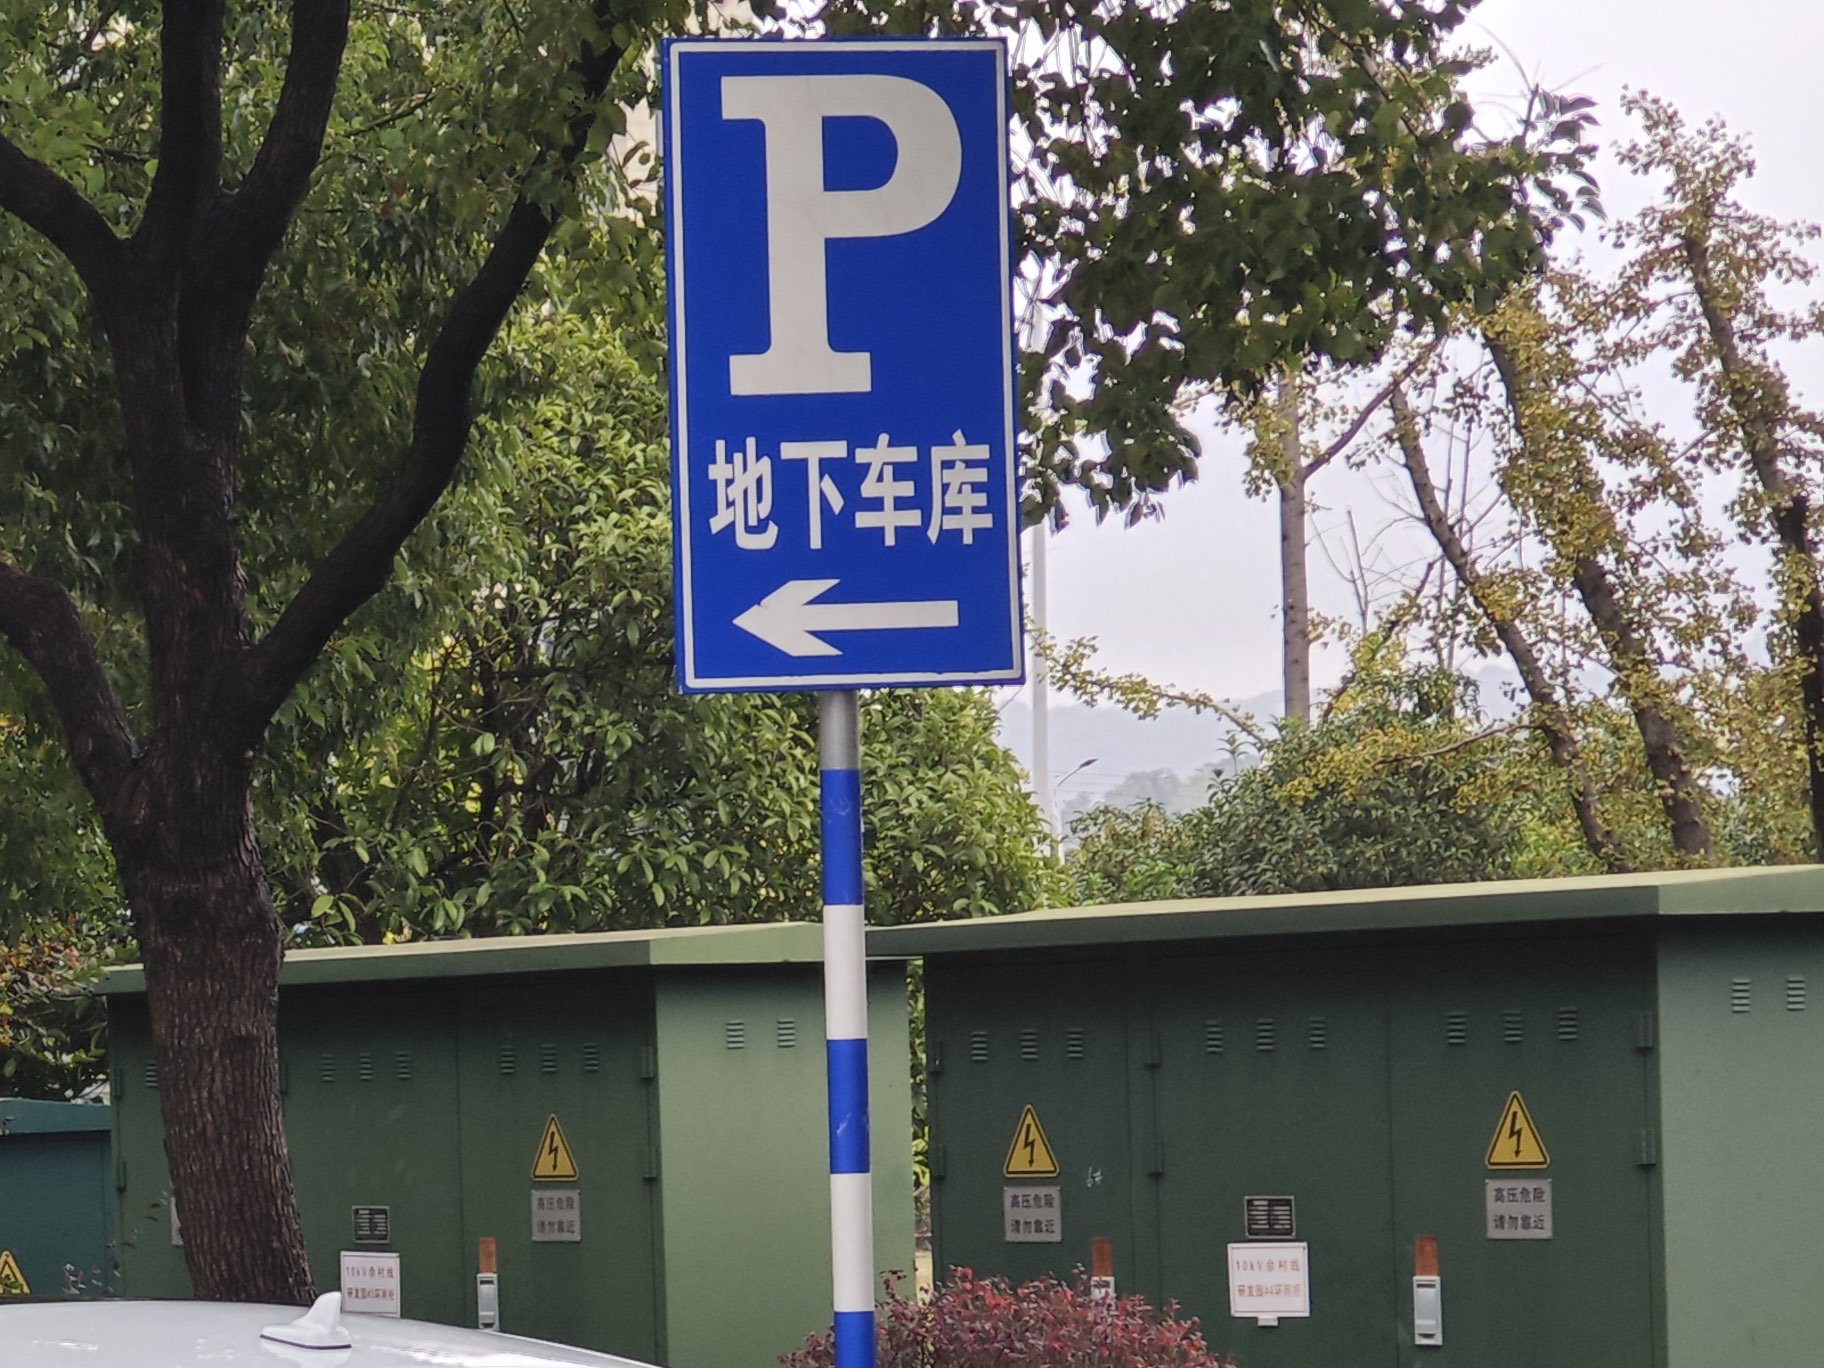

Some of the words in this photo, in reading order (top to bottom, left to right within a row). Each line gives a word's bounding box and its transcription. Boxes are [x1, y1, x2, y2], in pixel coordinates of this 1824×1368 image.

[721, 74, 963, 396] P
[707, 428, 994, 551] 地下车库
[1493, 1186, 1546, 1204] 高压危险
[1493, 1214, 1546, 1231] 请勿靠近
